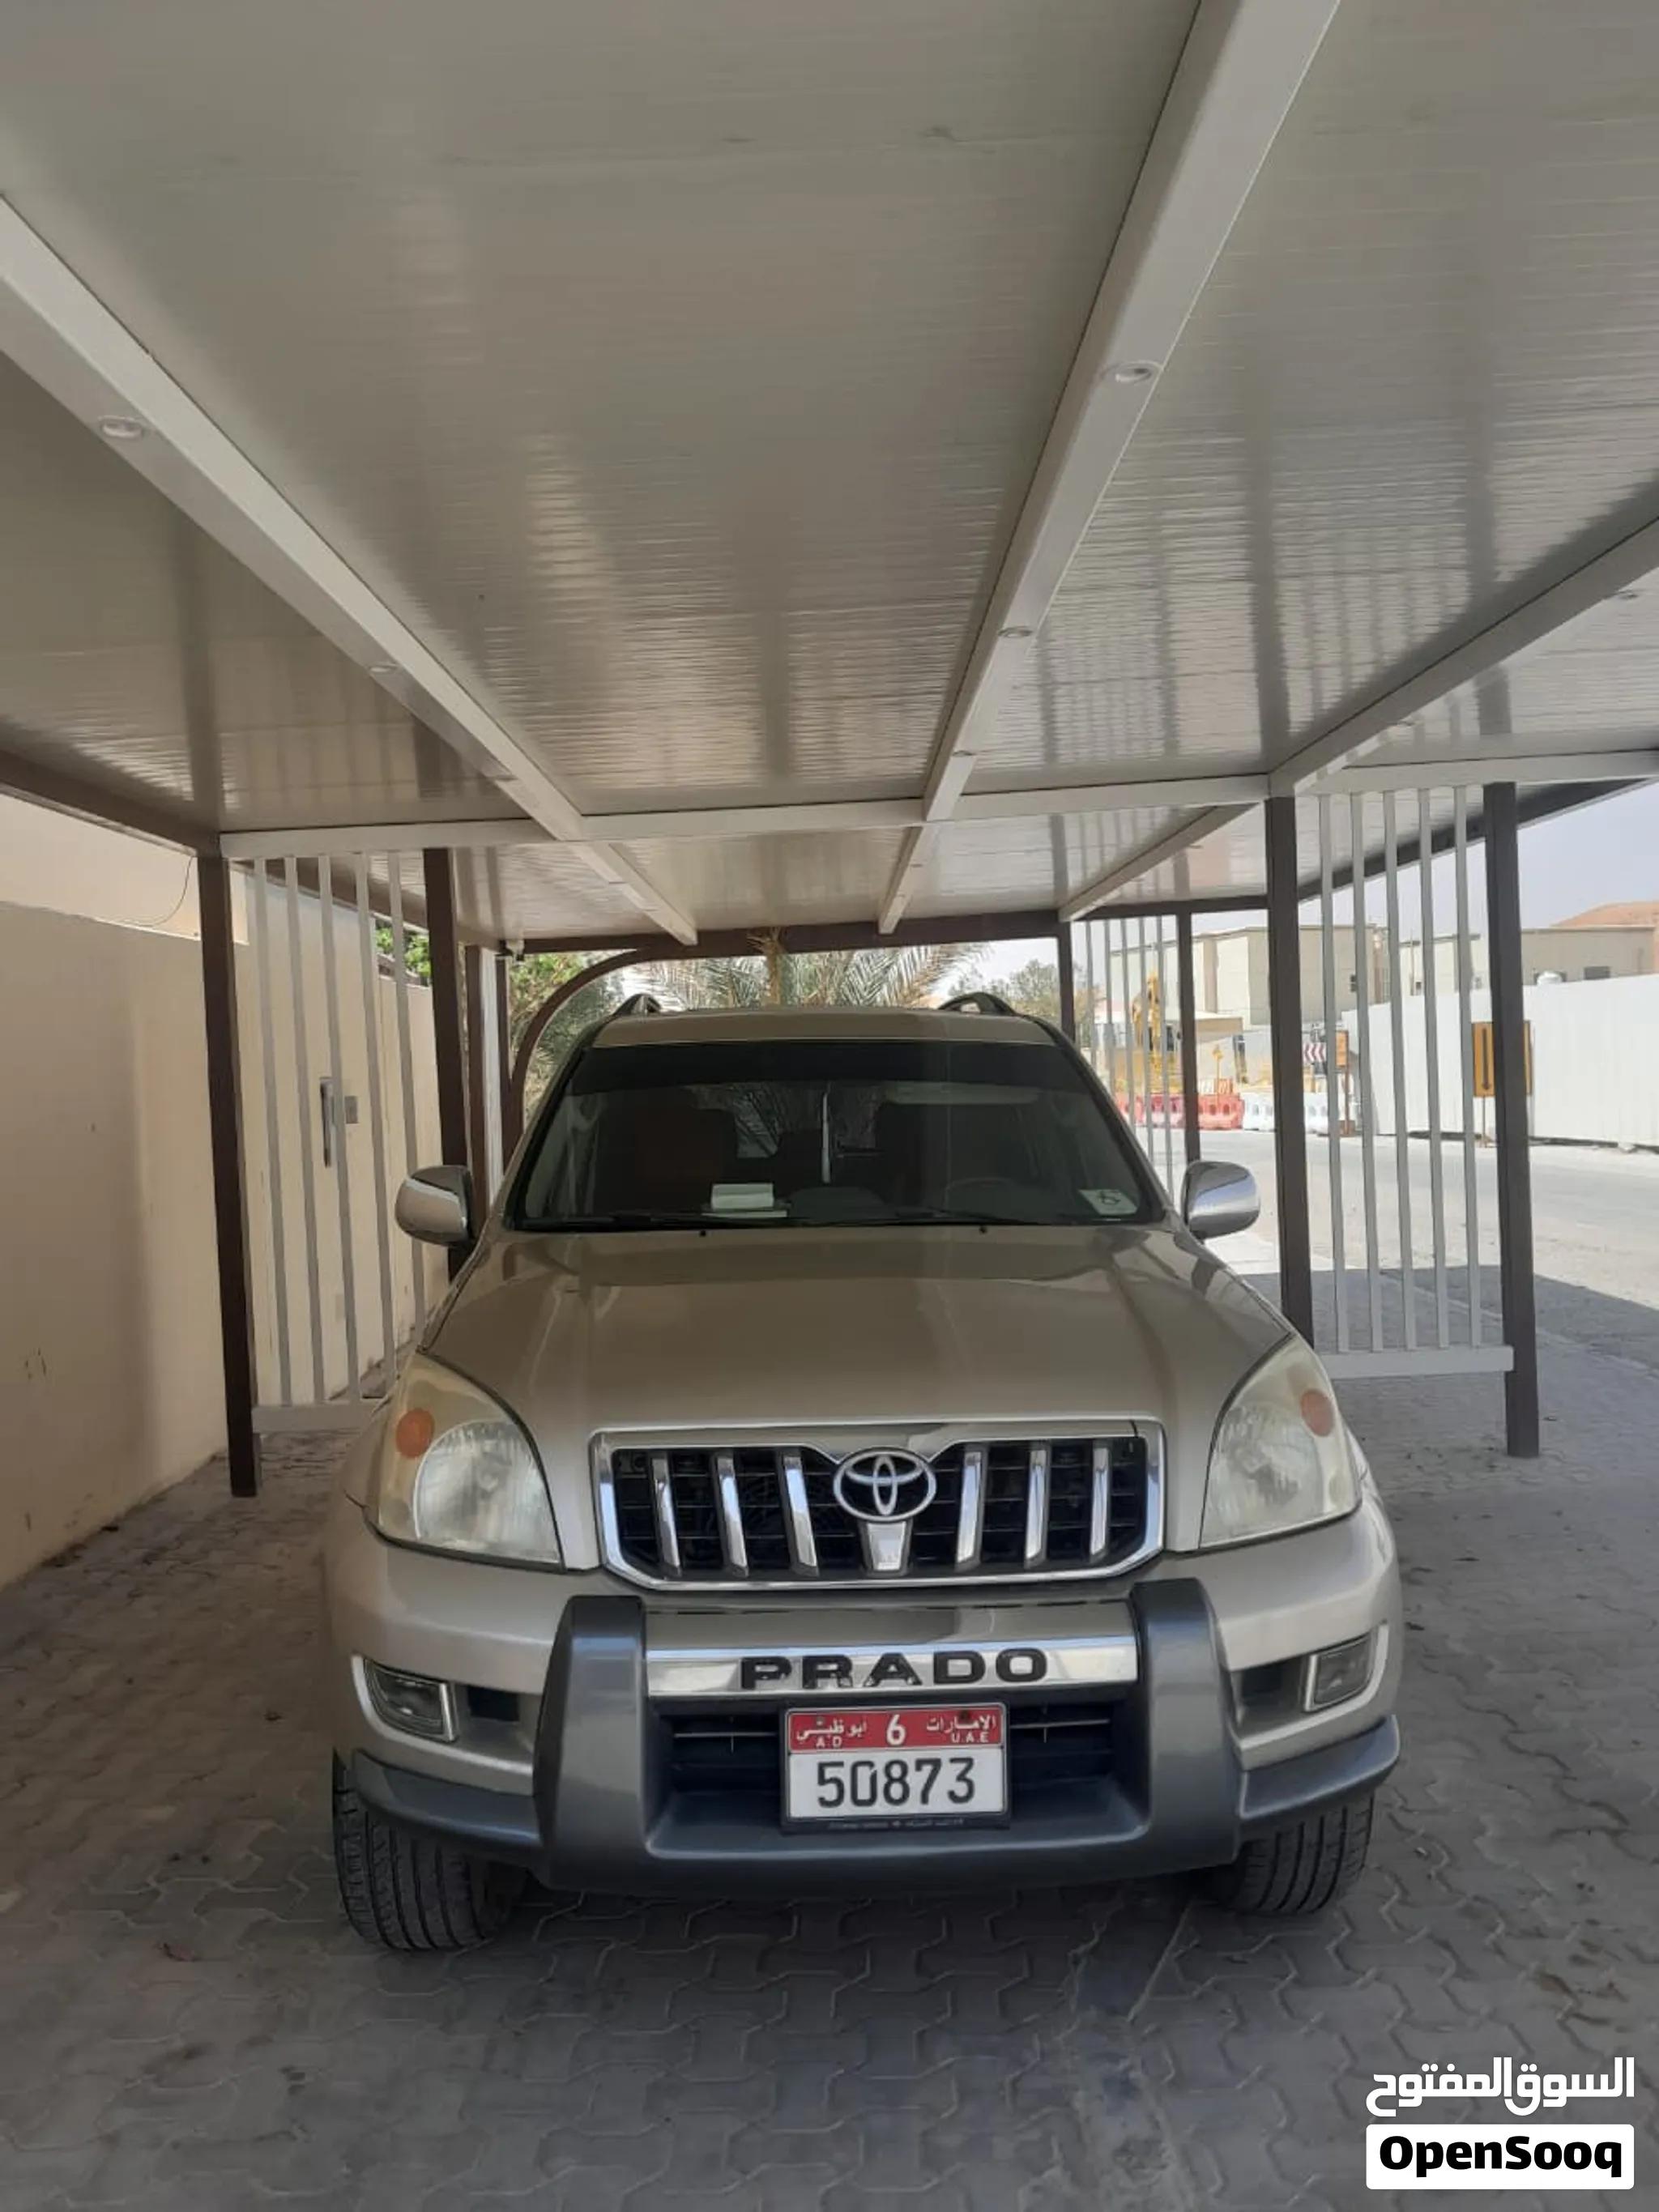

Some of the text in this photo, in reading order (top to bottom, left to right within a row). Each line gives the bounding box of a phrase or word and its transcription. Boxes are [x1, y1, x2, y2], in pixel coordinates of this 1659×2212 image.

[740, 1647, 1049, 1690] PRADO
[886, 1714, 906, 1745] 6
[817, 1758, 975, 1808] 50873
